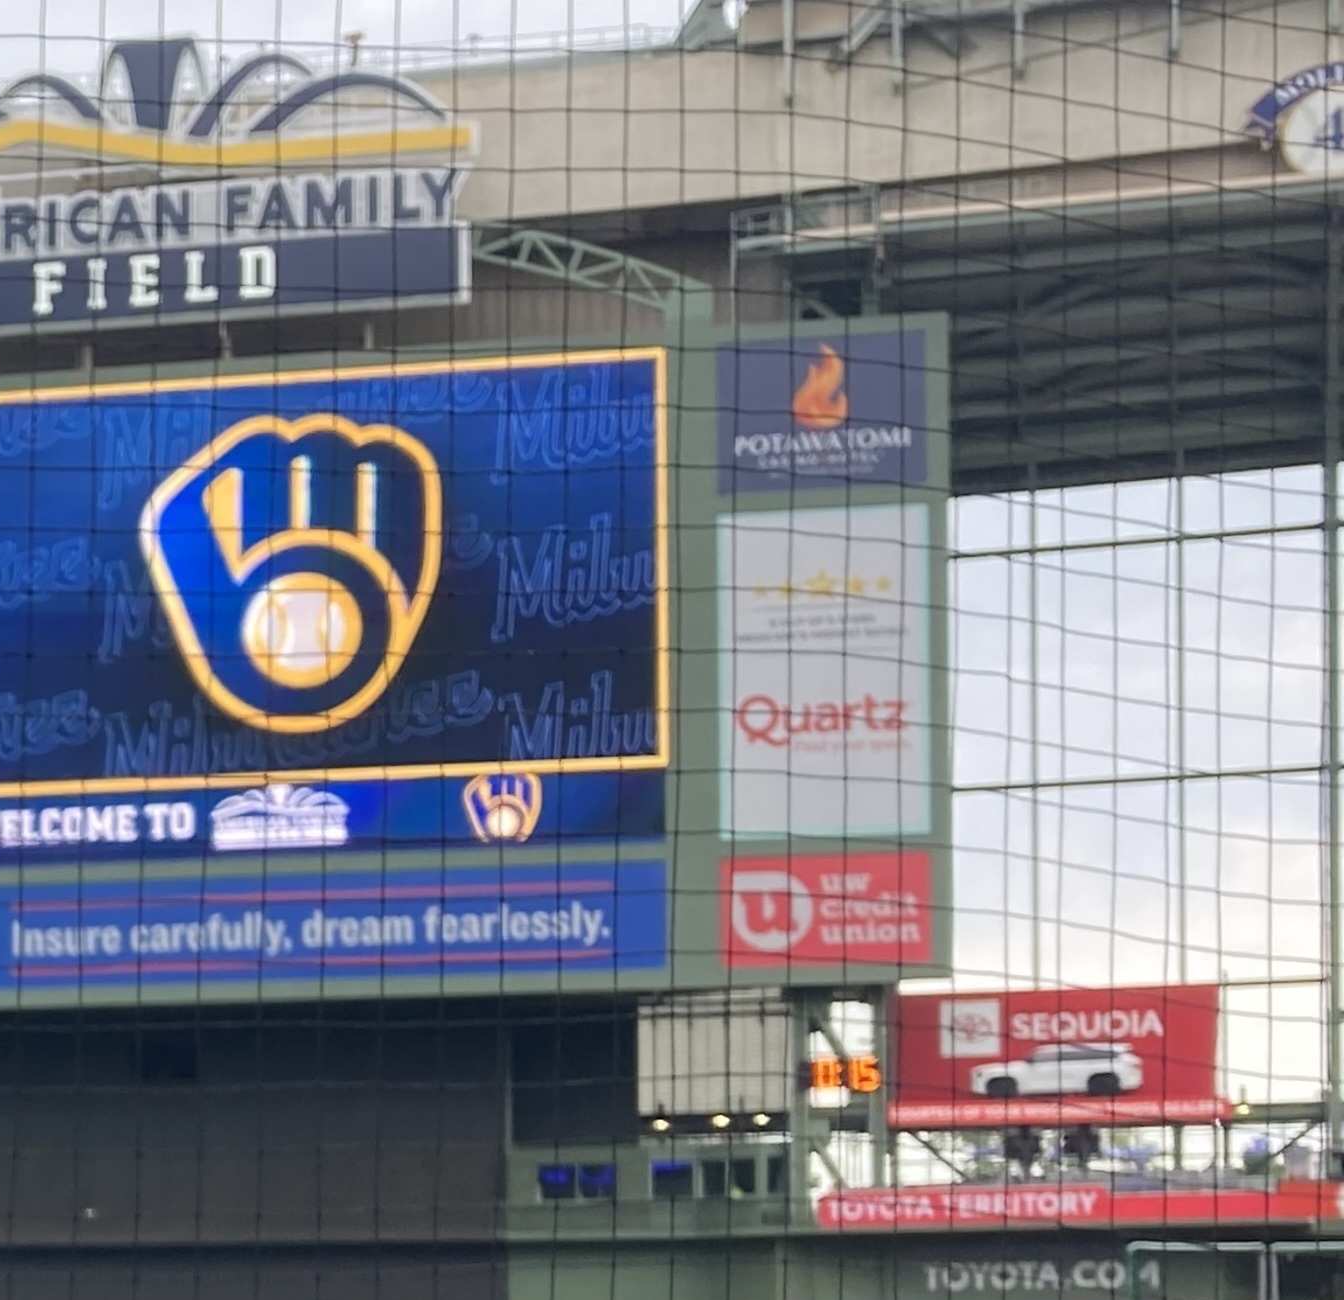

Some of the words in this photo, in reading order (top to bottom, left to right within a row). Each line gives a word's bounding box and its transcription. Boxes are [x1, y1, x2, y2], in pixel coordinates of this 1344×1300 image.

[225, 167, 458, 232] FAMILY
[31, 244, 278, 317] FIELD
[734, 426, 912, 458] POTAWATOMI
[737, 693, 909, 748] Quartz
[145, 801, 197, 841] TO
[819, 872, 872, 893] uw
[819, 891, 919, 919] credit
[12, 919, 123, 960] Insure
[129, 910, 295, 958] carefully,
[301, 908, 416, 947] dream
[422, 900, 611, 947] fearlessly.
[819, 919, 921, 944] union
[1011, 1008, 1164, 1041] SEQUOIA
[828, 1199, 934, 1222] TOYOTA
[940, 1190, 1098, 1219] TERRITORY
